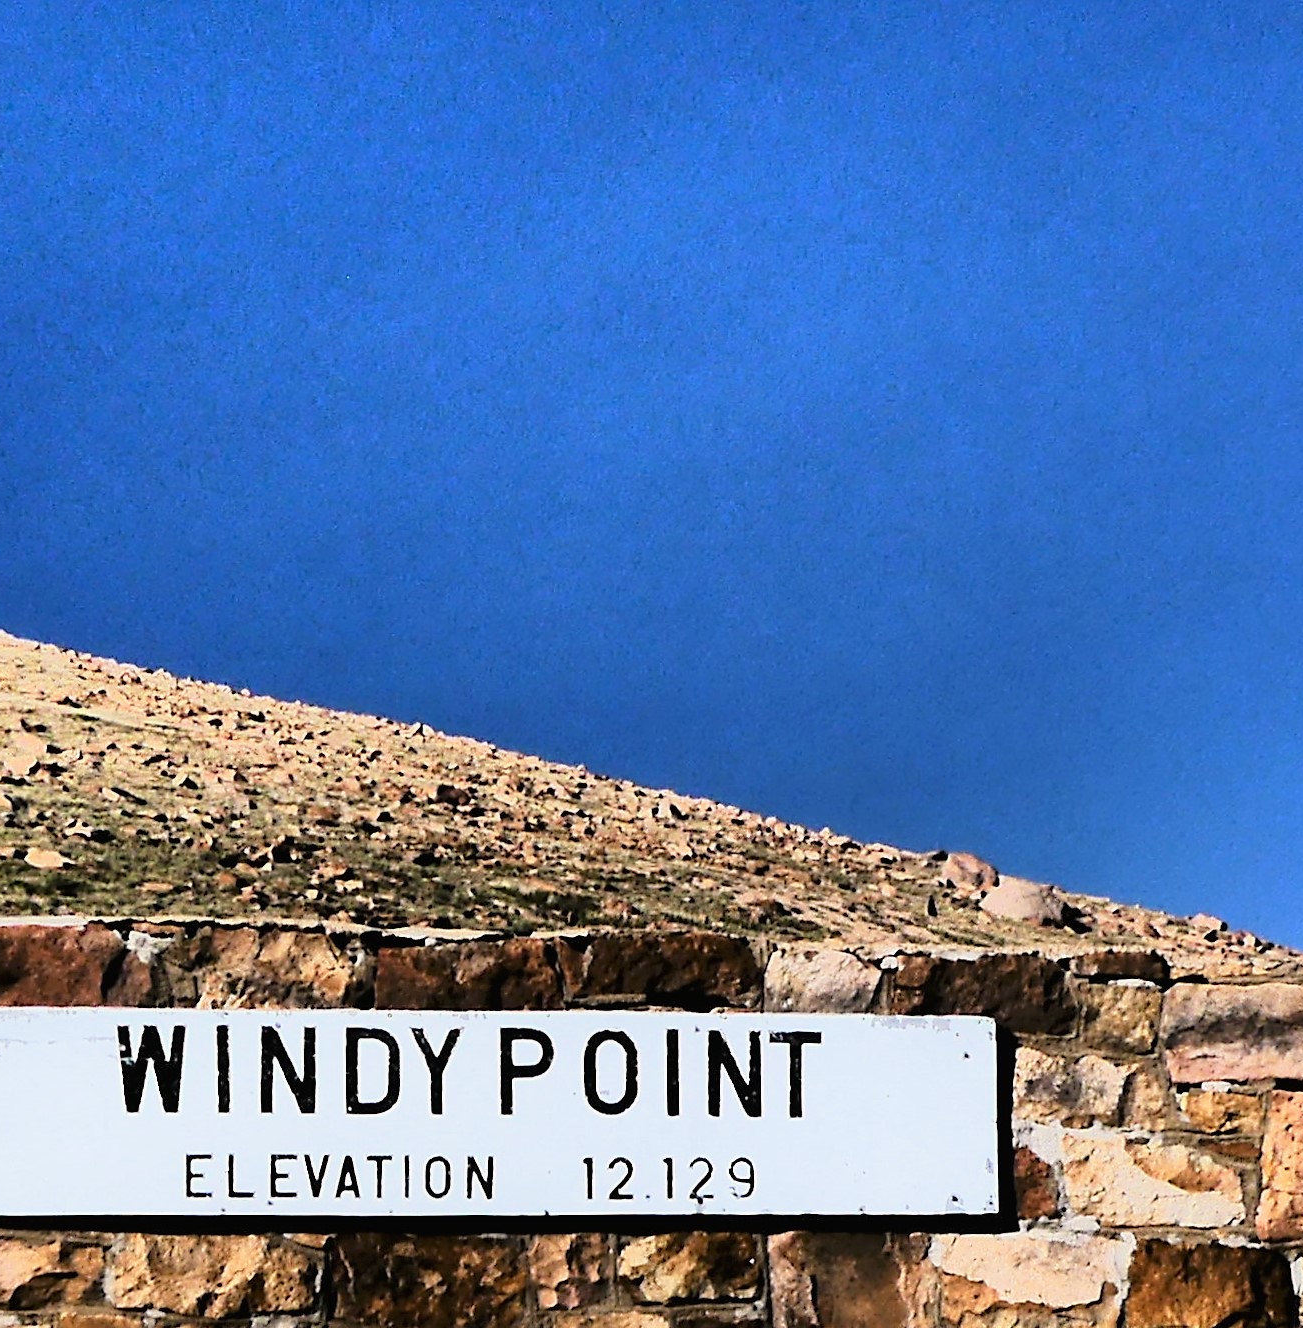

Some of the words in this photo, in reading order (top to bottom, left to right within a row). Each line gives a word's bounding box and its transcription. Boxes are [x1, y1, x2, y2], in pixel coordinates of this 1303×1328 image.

[118, 1025, 463, 1115] WINDY
[500, 1028, 823, 1118] POINT
[186, 1154, 494, 1200] ELEVATION
